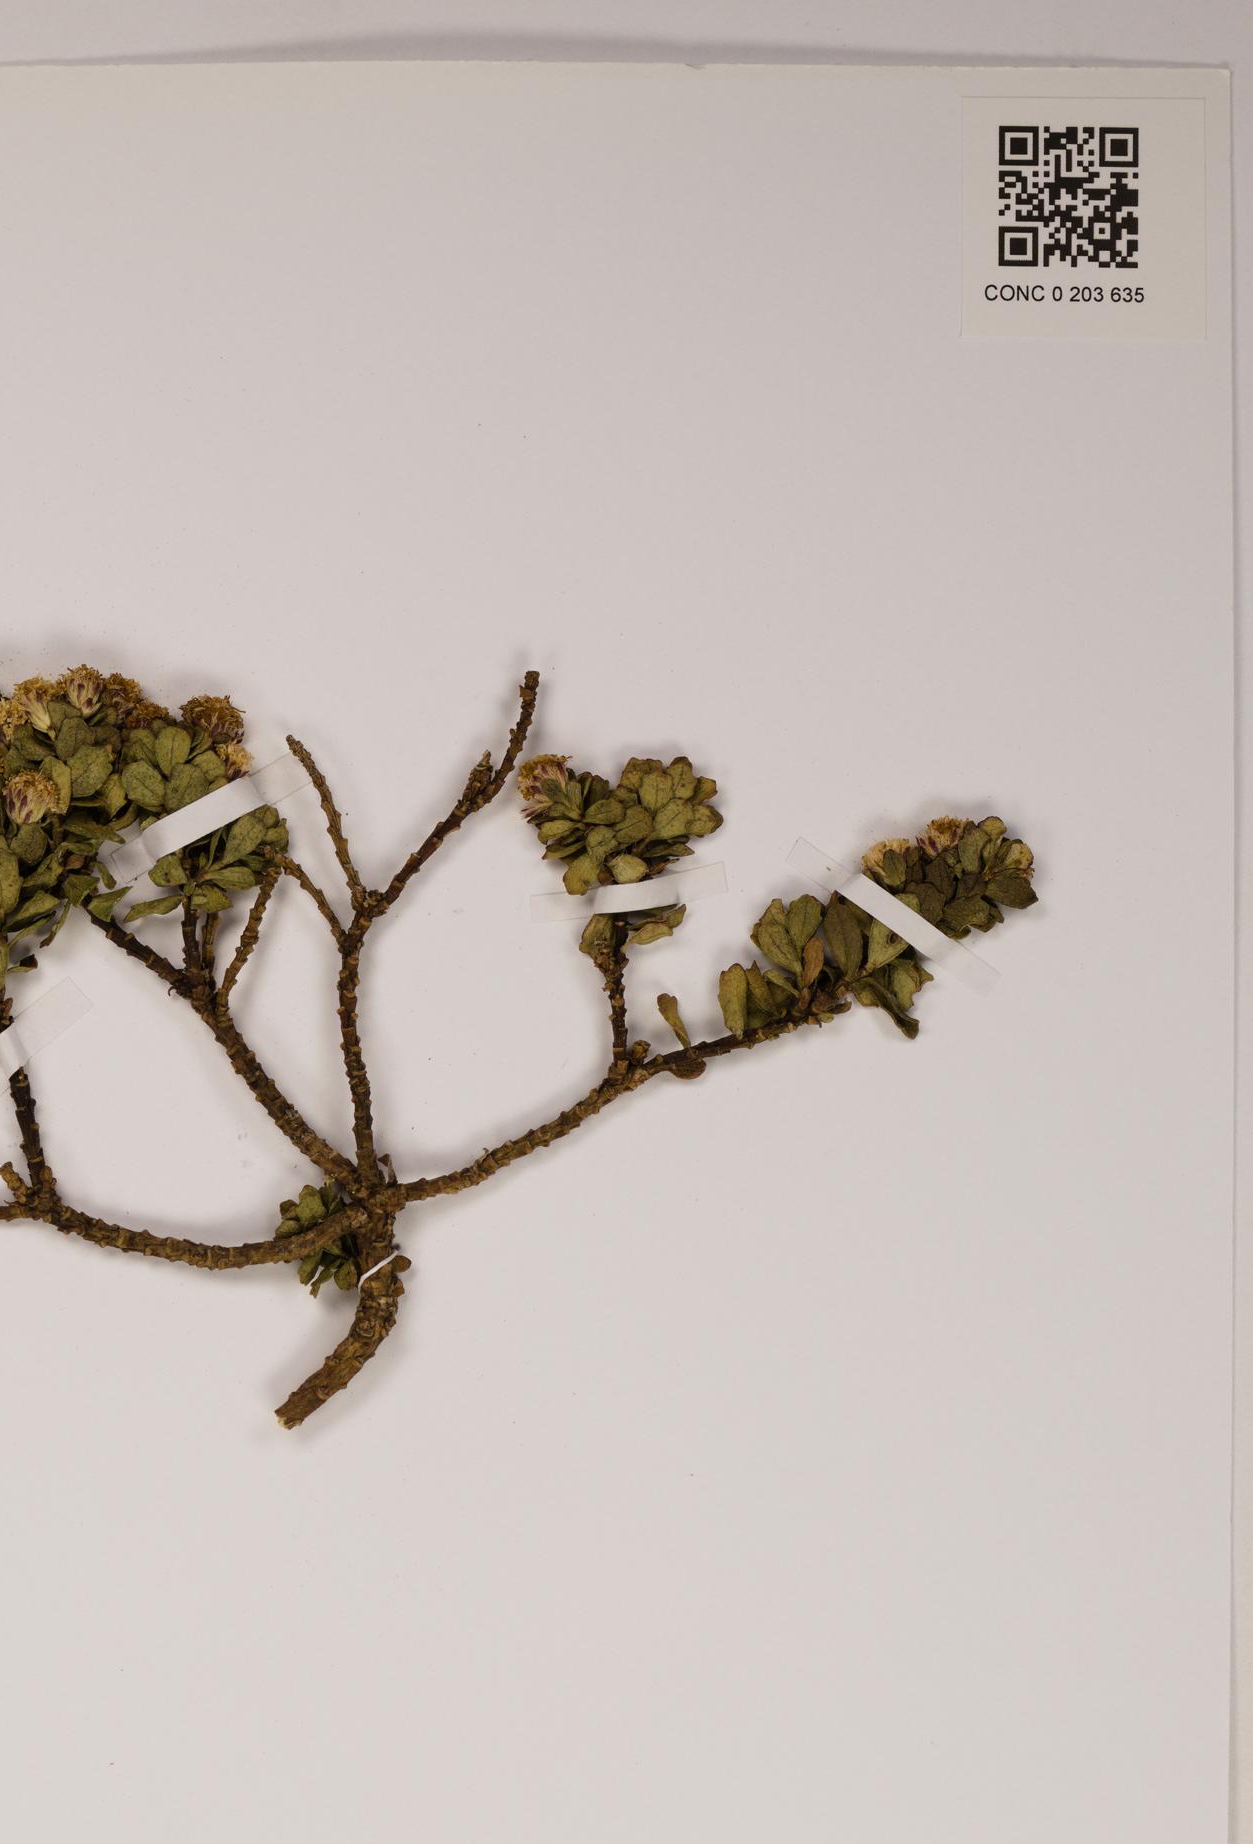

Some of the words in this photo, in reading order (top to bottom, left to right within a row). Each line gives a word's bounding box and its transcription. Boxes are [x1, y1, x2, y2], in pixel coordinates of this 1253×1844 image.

[984, 284, 1045, 302] CONC
[1052, 286, 1063, 302] 0
[1069, 286, 1104, 303] 203
[1110, 286, 1145, 304] 635
